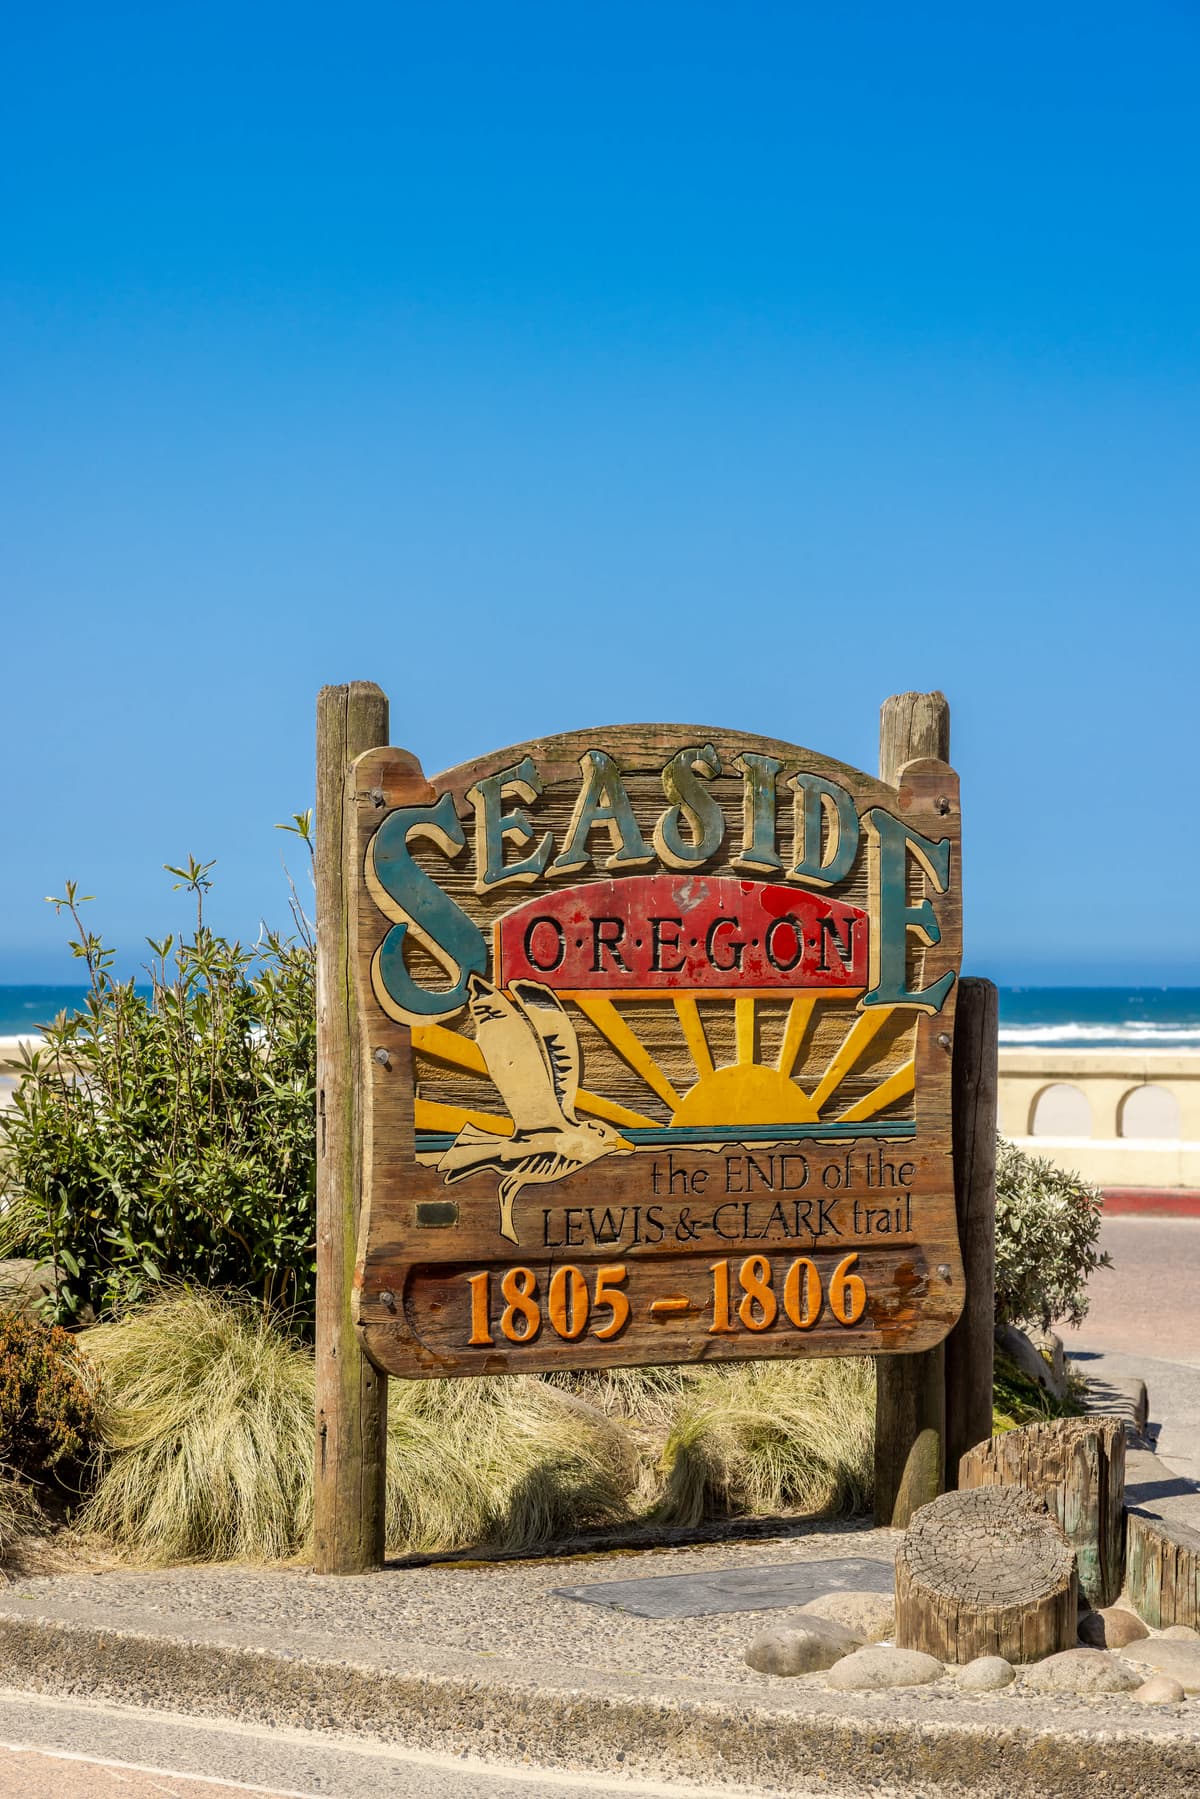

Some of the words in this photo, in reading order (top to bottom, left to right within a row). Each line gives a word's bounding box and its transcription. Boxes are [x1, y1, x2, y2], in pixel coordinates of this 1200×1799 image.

[365, 743, 956, 1026] SEASIDE
[651, 1154, 709, 1195] the
[724, 1154, 810, 1194] END
[822, 1149, 855, 1190] of
[866, 1148, 917, 1189] the
[541, 1205, 665, 1249] LEWIS
[675, 1206, 702, 1242] &
[711, 1199, 843, 1240] CLARK
[853, 1192, 913, 1236] trail
[467, 1264, 631, 1347] 1805
[708, 1252, 868, 1335] 1806
